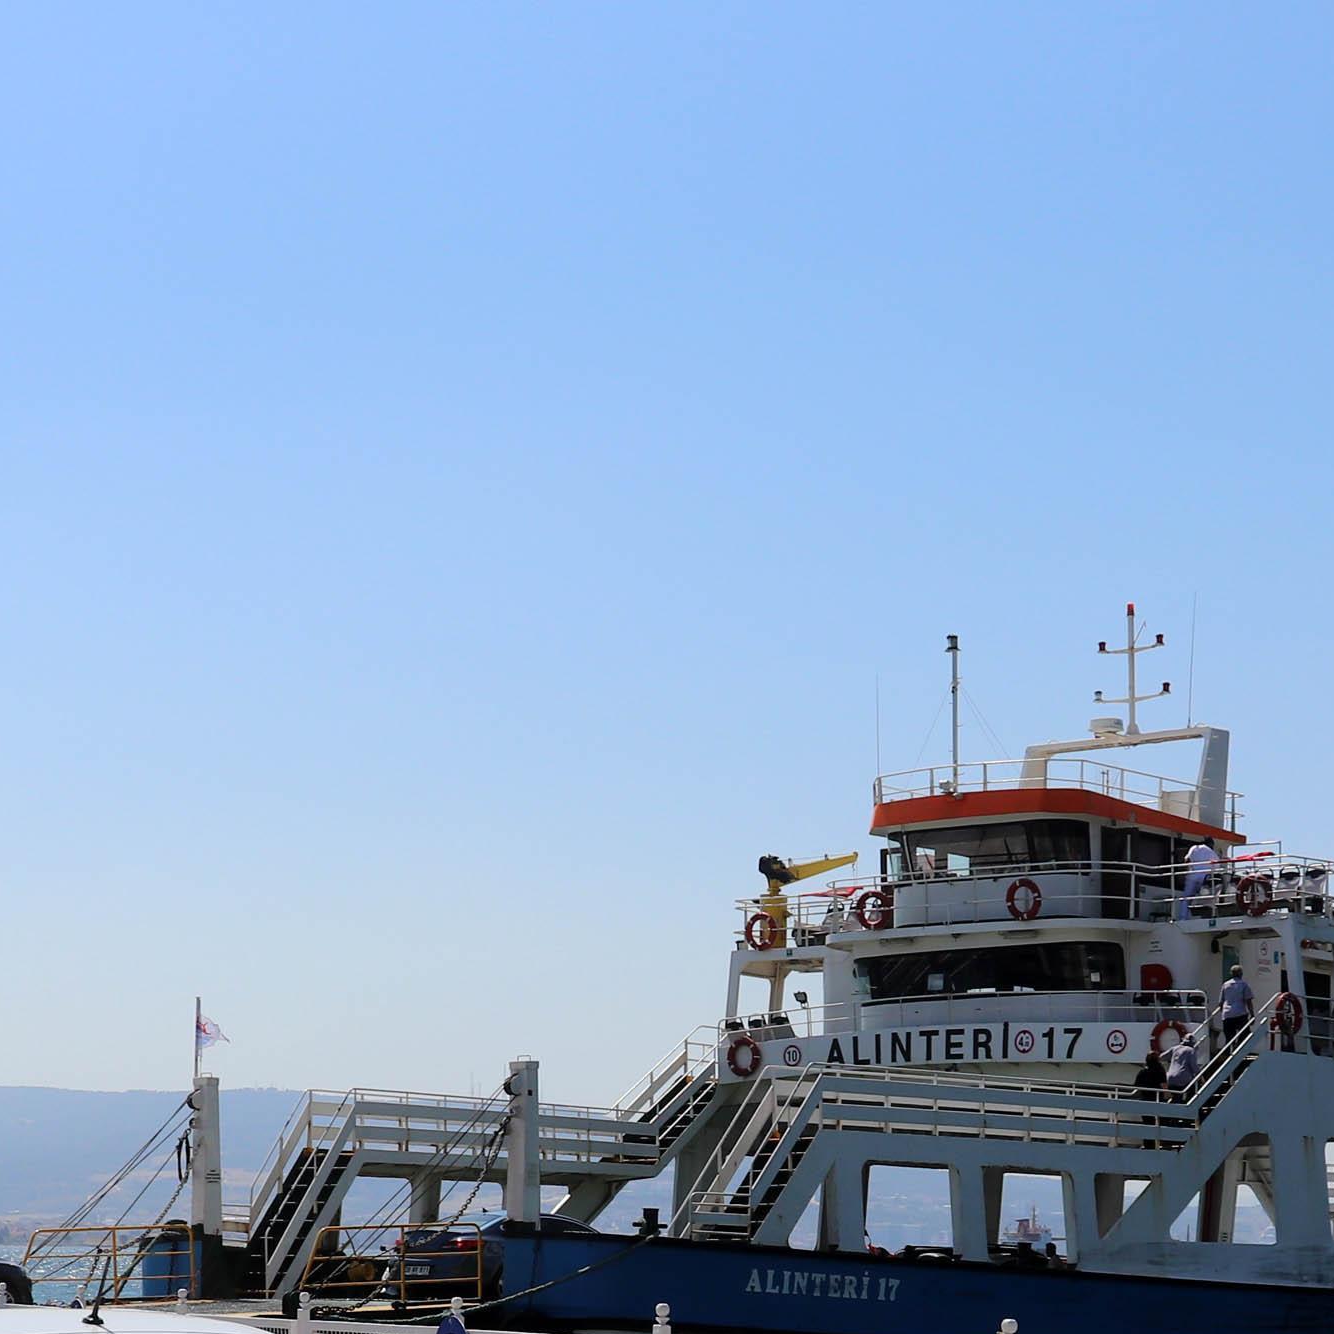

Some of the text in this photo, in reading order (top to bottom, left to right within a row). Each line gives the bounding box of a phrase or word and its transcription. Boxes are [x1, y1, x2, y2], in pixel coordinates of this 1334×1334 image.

[786, 1049, 798, 1062] 10
[1042, 1027, 1083, 1059] 17
[744, 1267, 901, 1302] ALINTERİ 17
